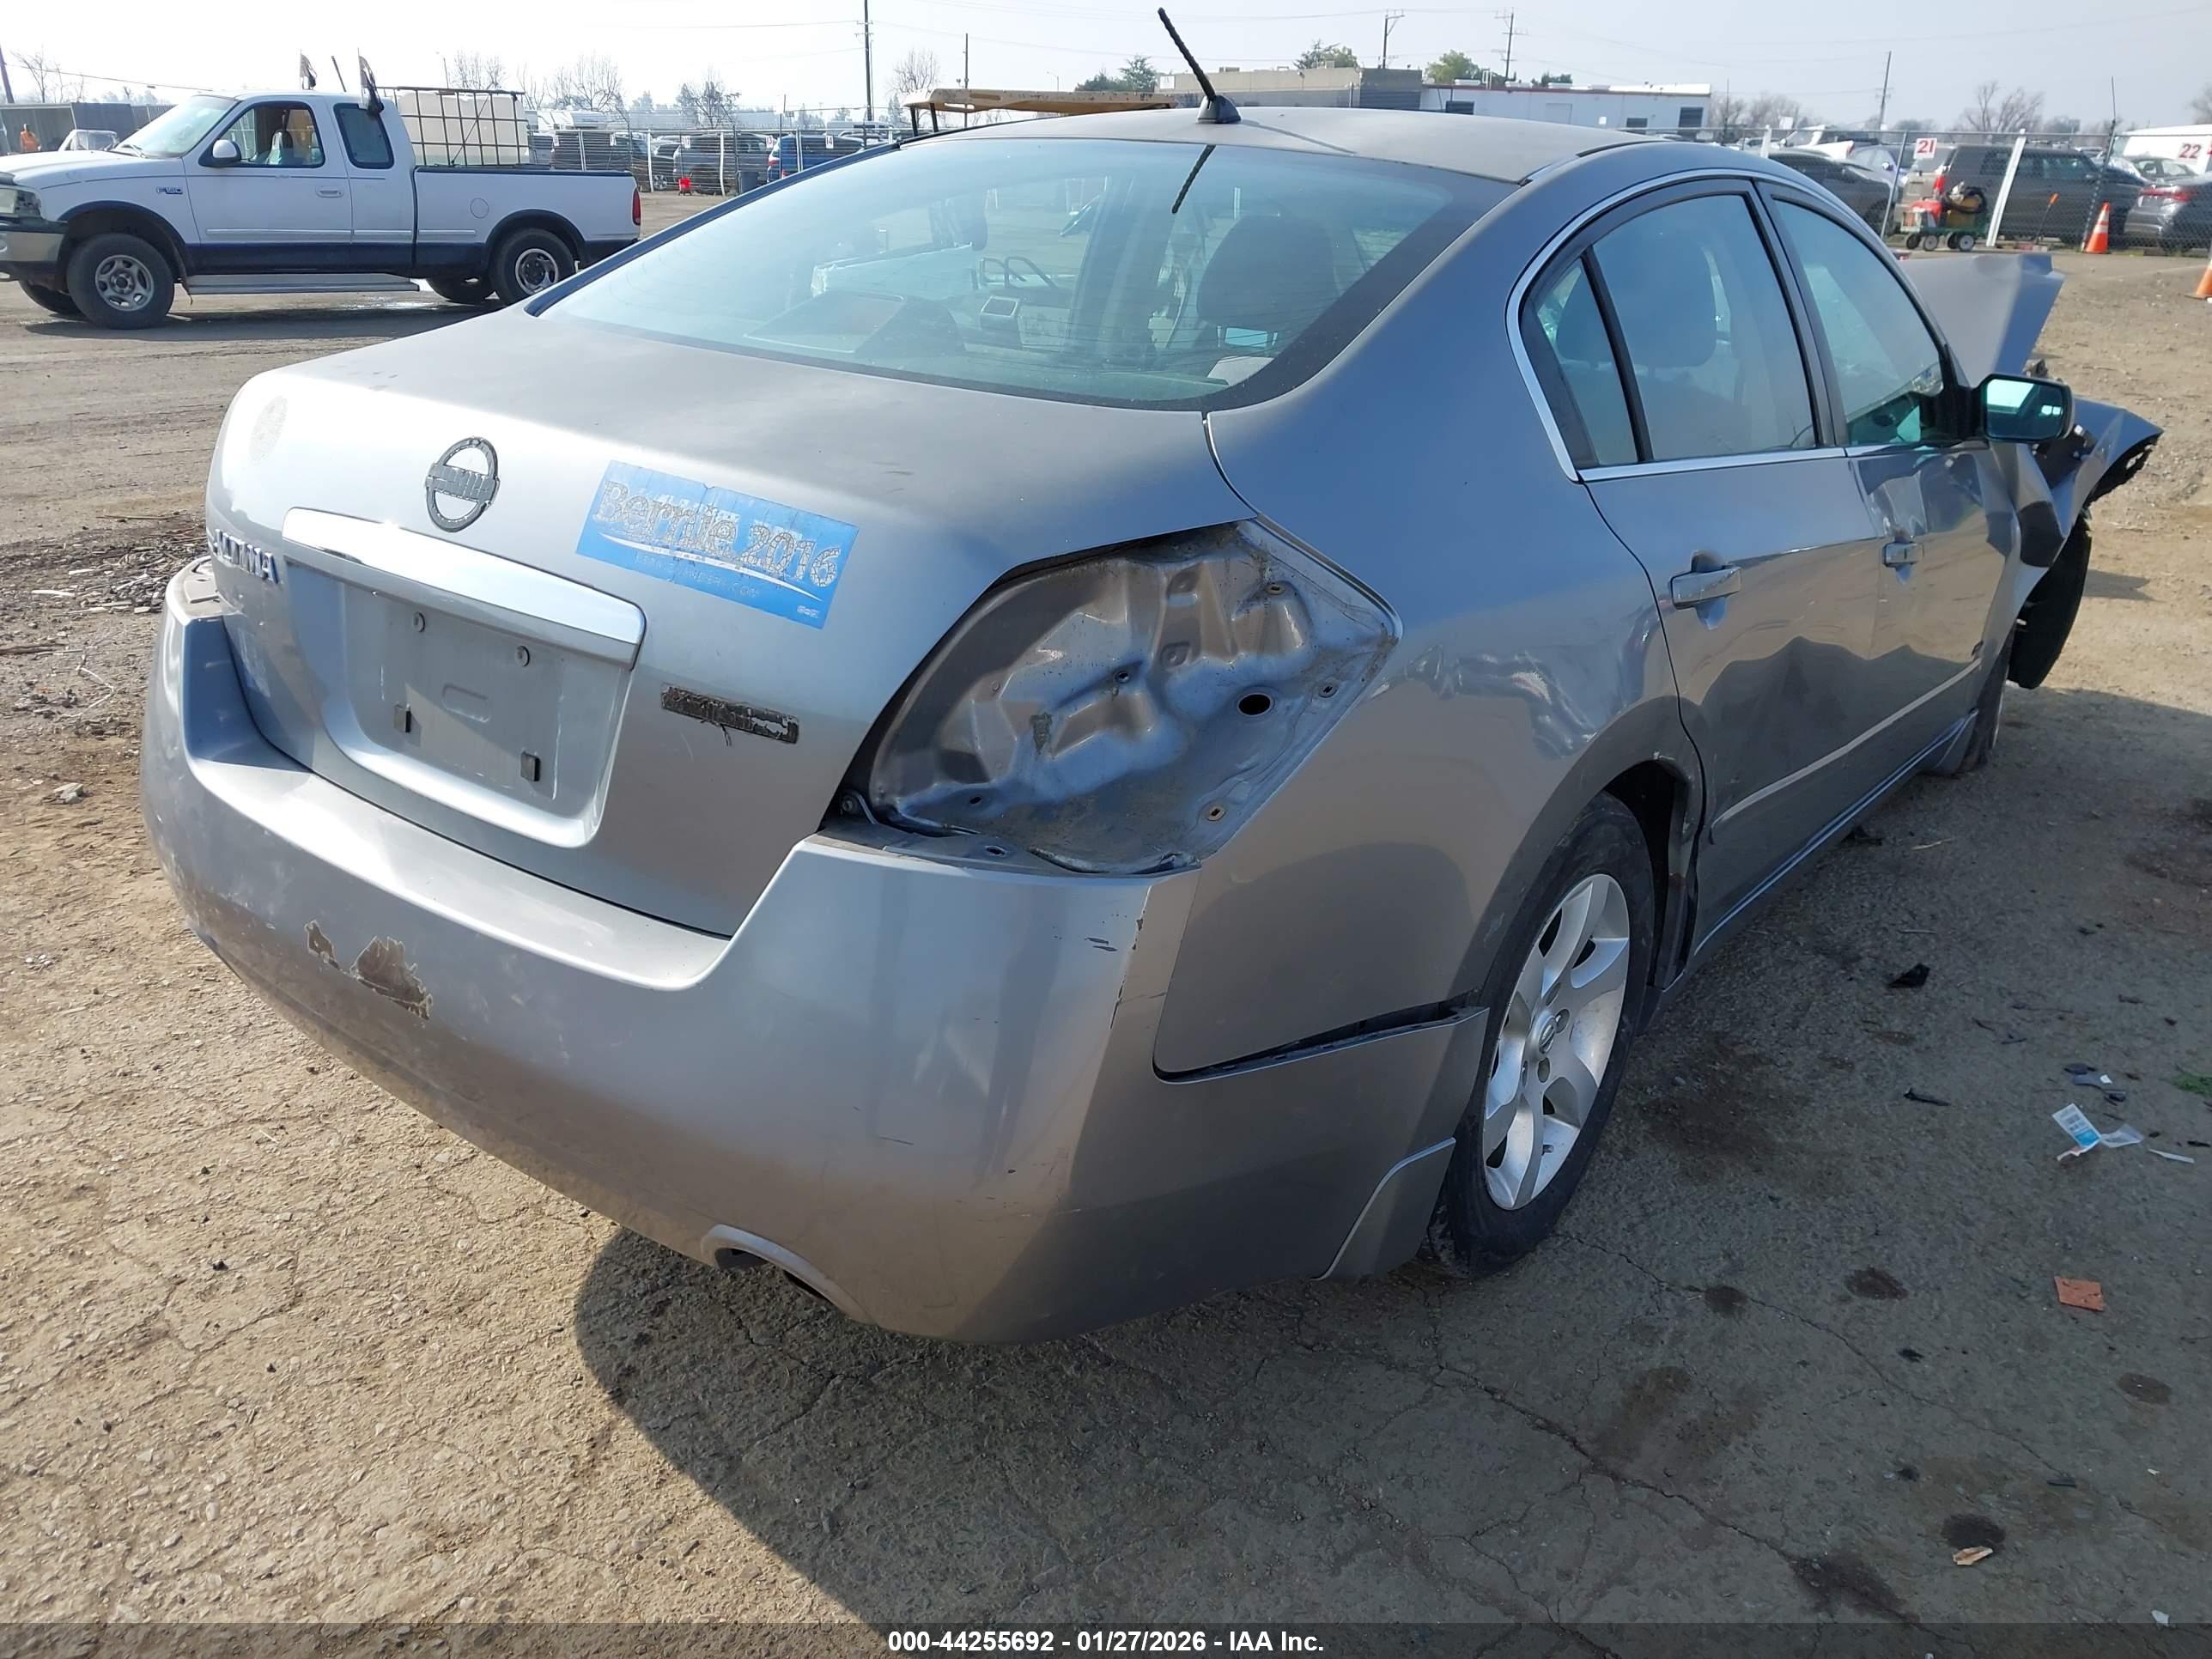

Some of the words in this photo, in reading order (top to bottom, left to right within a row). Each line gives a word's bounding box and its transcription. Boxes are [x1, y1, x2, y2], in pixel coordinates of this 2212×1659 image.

[1917, 140, 1935, 154] 21
[2179, 143, 2203, 159] 22
[594, 479, 737, 554] Bernie
[740, 524, 842, 588] 2016
